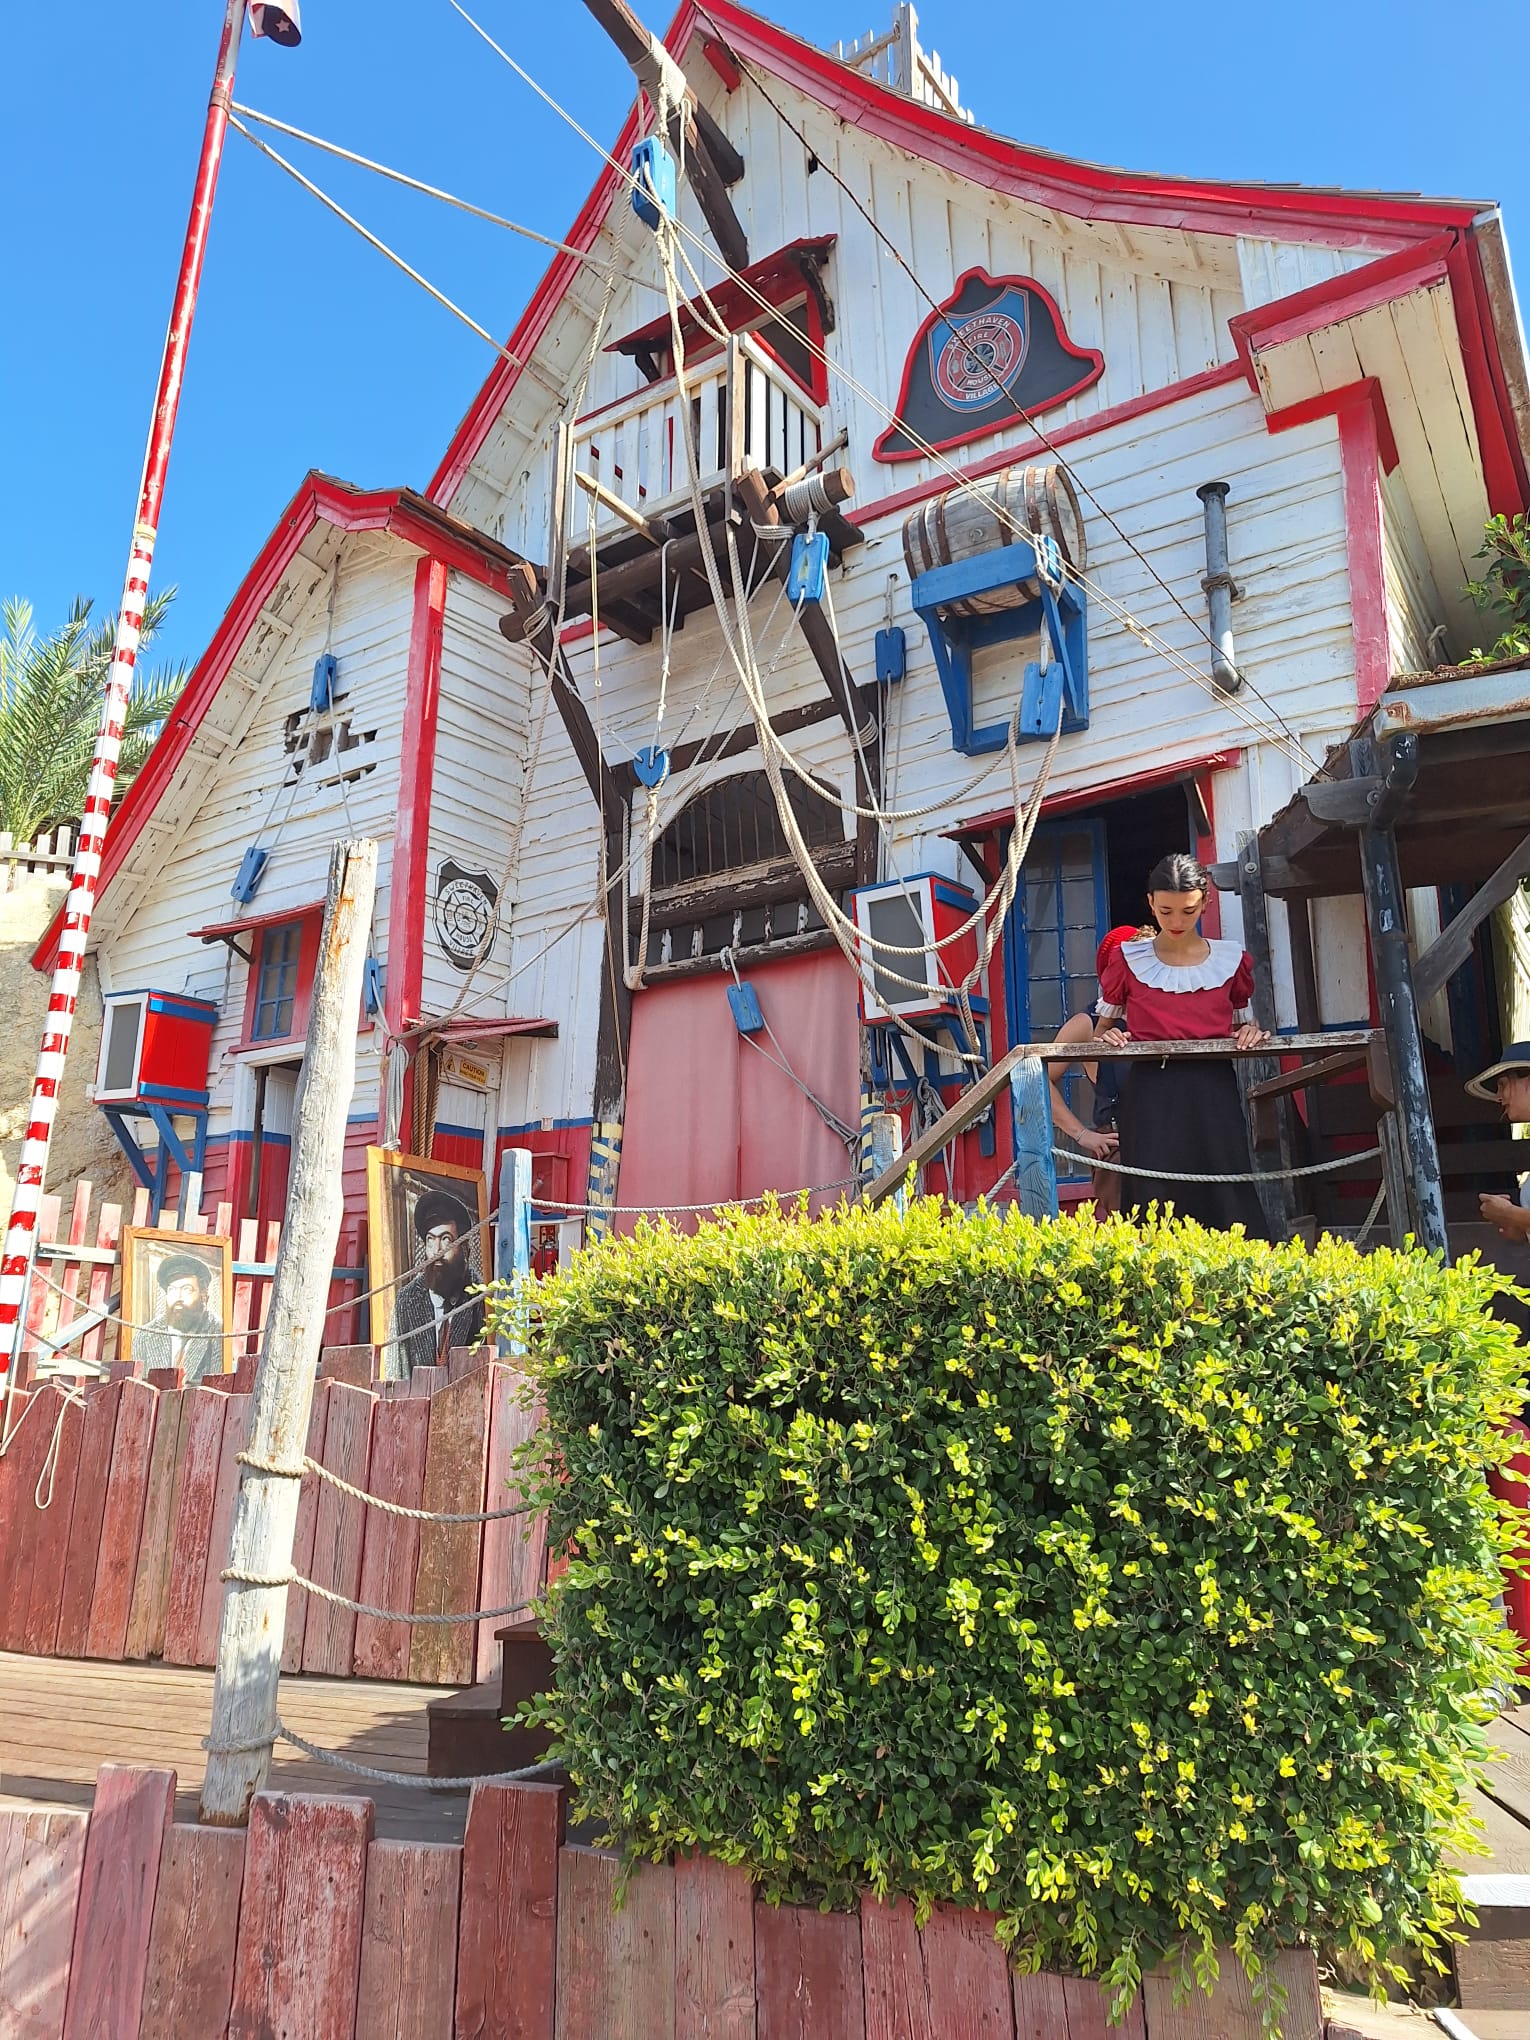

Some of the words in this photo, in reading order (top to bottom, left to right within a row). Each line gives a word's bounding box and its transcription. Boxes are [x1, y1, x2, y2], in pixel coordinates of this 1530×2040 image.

[946, 317, 1011, 350] SWEETHAVEN
[967, 331, 989, 344] FIRE
[462, 1062, 485, 1077] CAUTION
